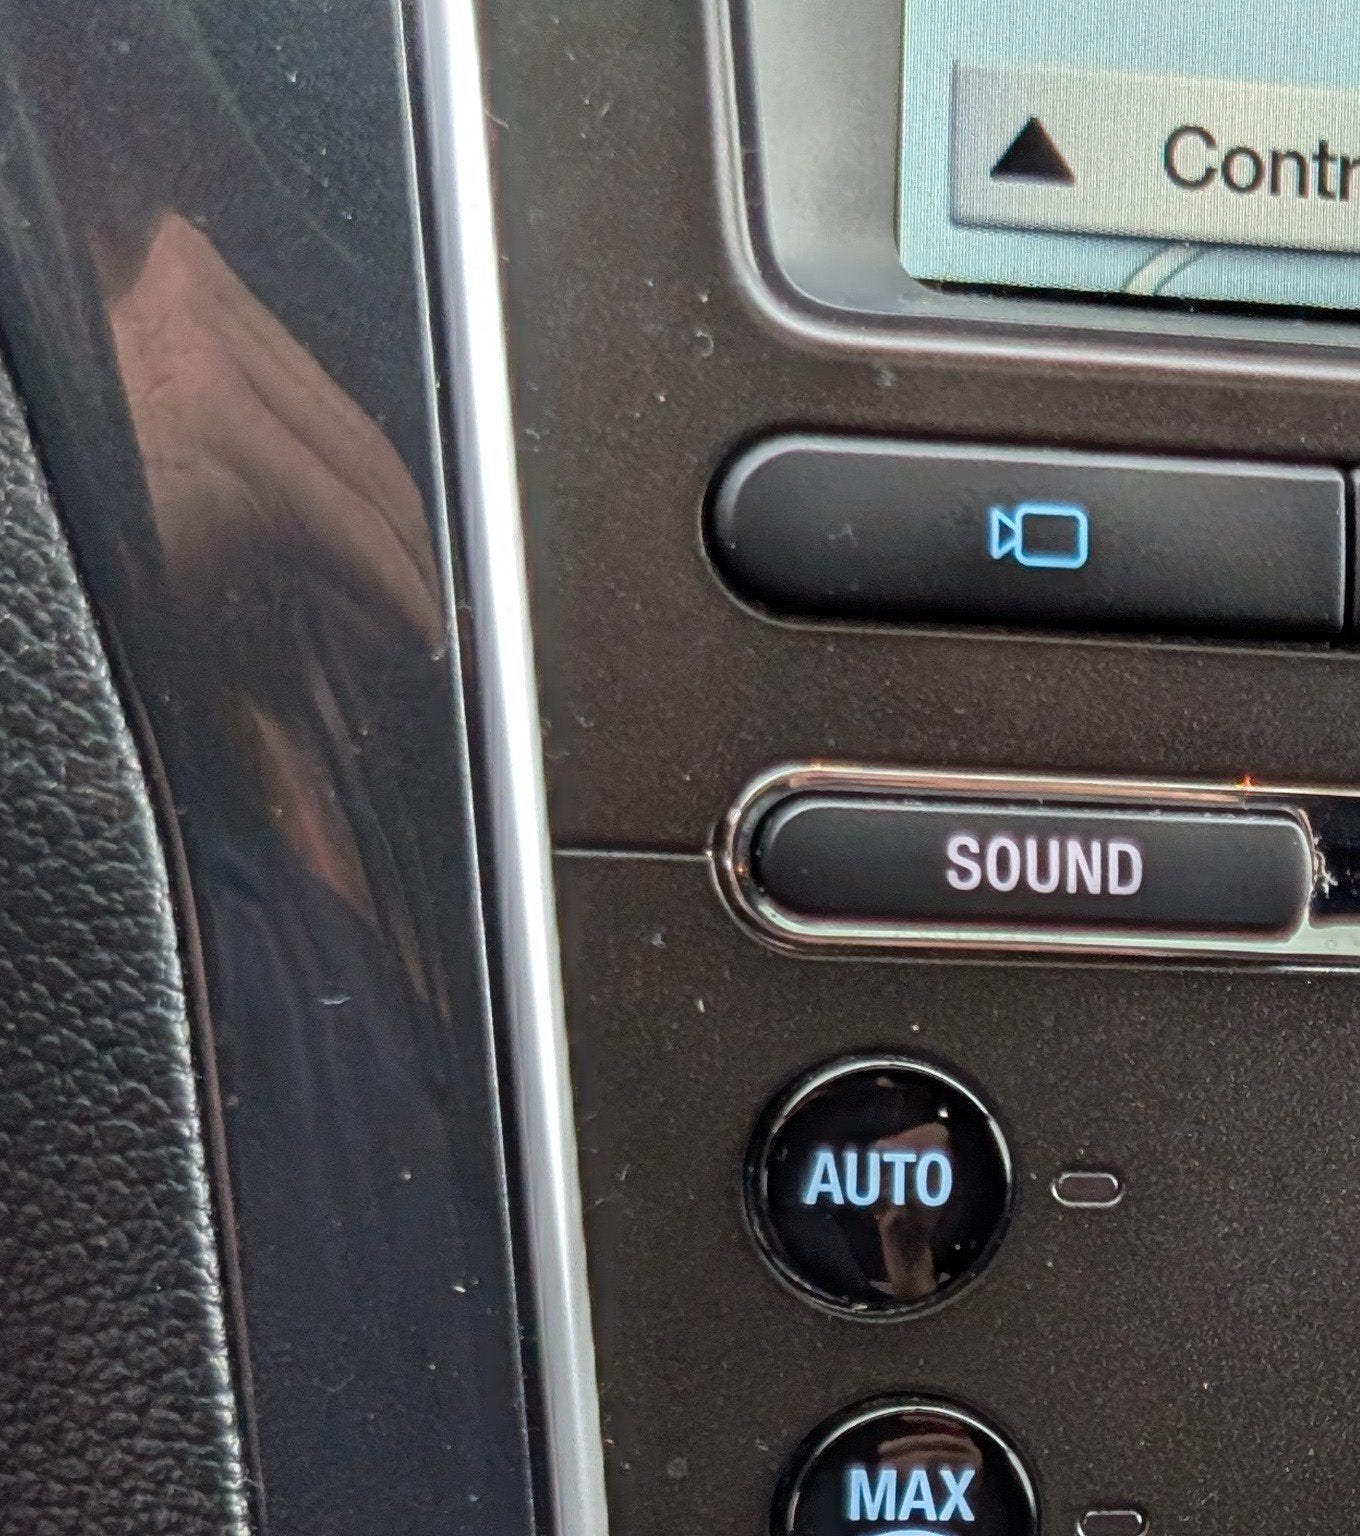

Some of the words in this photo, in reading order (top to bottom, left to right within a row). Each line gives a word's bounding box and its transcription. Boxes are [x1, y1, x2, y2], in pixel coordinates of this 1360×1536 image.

[946, 836, 1144, 898] SOUND
[804, 1150, 953, 1207] AUTO
[846, 1467, 975, 1522] MAX
